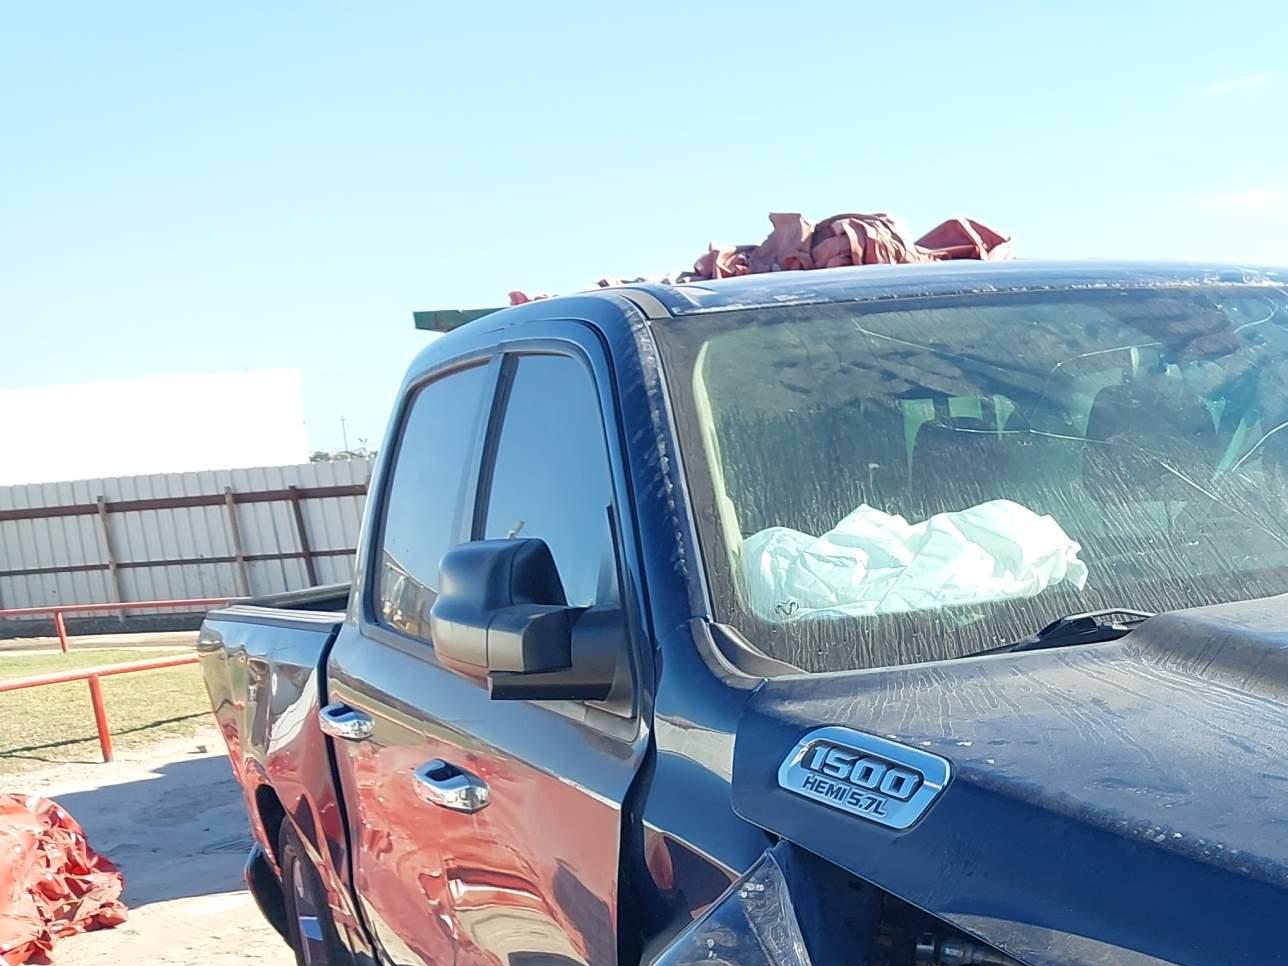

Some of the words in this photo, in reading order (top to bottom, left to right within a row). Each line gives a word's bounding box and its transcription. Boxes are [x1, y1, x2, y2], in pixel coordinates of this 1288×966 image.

[802, 774, 846, 801] HEMI
[847, 791, 887, 816] 5.7L
[810, 746, 918, 799] 1500
